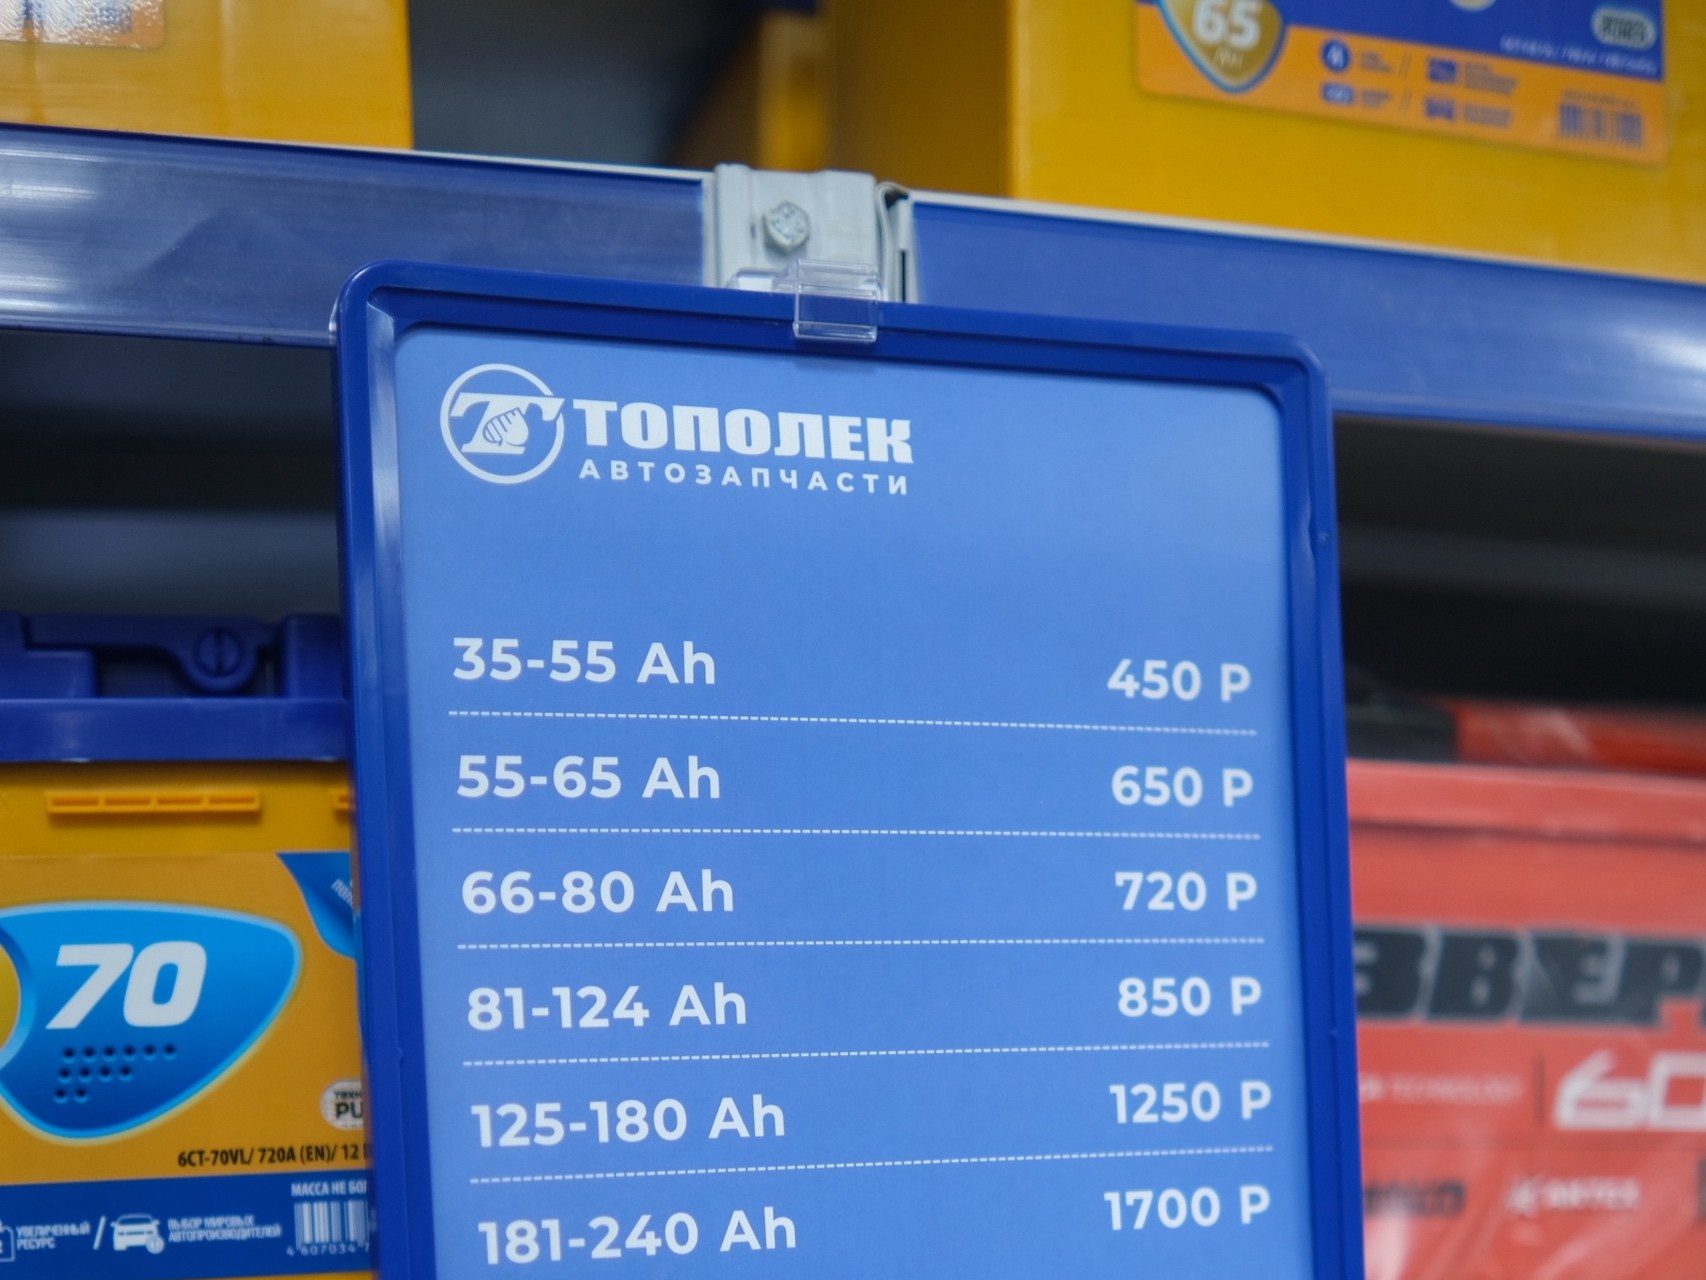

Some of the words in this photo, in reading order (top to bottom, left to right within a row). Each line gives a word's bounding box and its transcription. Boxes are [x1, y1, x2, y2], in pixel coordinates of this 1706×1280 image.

[573, 399, 914, 464] ТОПОЛЕК
[579, 459, 907, 495] АВТОЗАПЧАСТИ
[453, 637, 617, 682] 35-55
[636, 640, 716, 685] Ah
[1107, 658, 1202, 701] 450
[456, 755, 622, 798] 55-65
[642, 755, 721, 799] Ah
[1111, 765, 1204, 807] 650
[461, 870, 635, 914] 66-80
[655, 868, 734, 912] Ah
[1115, 871, 1207, 911] 720
[46, 941, 207, 1029] 70
[1118, 976, 1212, 1018] 850
[1352, 924, 1706, 1027] ЗВЕР
[467, 985, 650, 1031] 81-124
[669, 982, 747, 1026] Ah
[471, 1098, 688, 1148] 125-180
[708, 1094, 786, 1139] Ah
[1109, 1081, 1221, 1124] 1250
[258, 1147, 297, 1163] 720A
[342, 1144, 359, 1160] 12
[291, 1182, 329, 1197] МАССА
[332, 1181, 347, 1195] НЕ
[1104, 1187, 1221, 1231] 1700
[478, 1212, 699, 1265] 181-240
[719, 1206, 797, 1252] Ah
